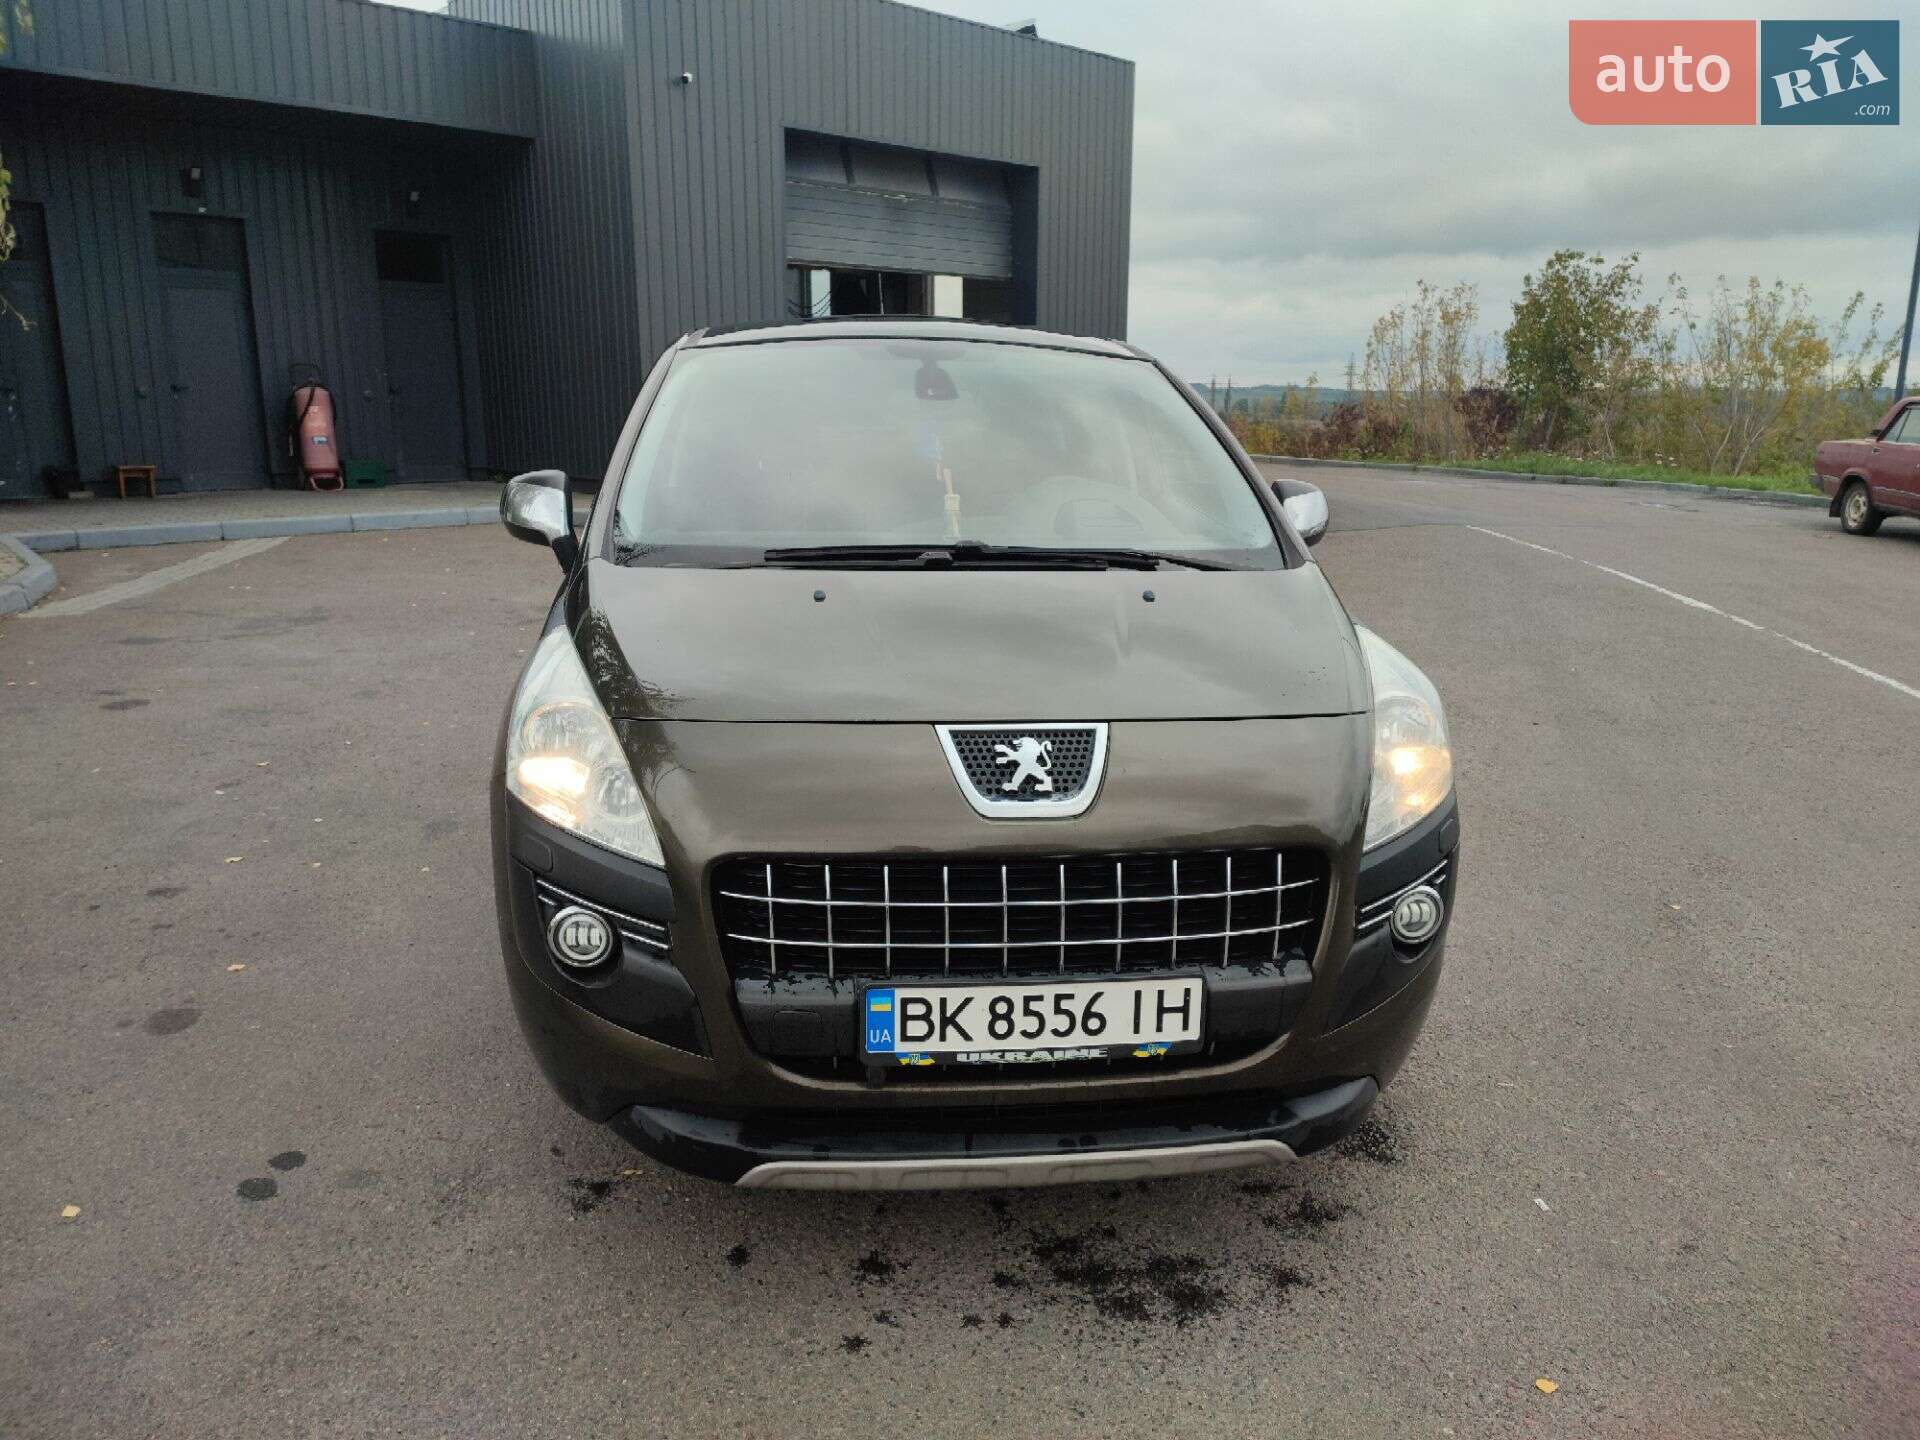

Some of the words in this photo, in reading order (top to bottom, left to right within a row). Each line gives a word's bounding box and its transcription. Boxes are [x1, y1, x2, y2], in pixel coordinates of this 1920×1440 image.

[900, 996, 974, 1042] BK
[988, 991, 1107, 1041] 8556
[1133, 987, 1190, 1034] IH
[870, 1029, 891, 1044] UA
